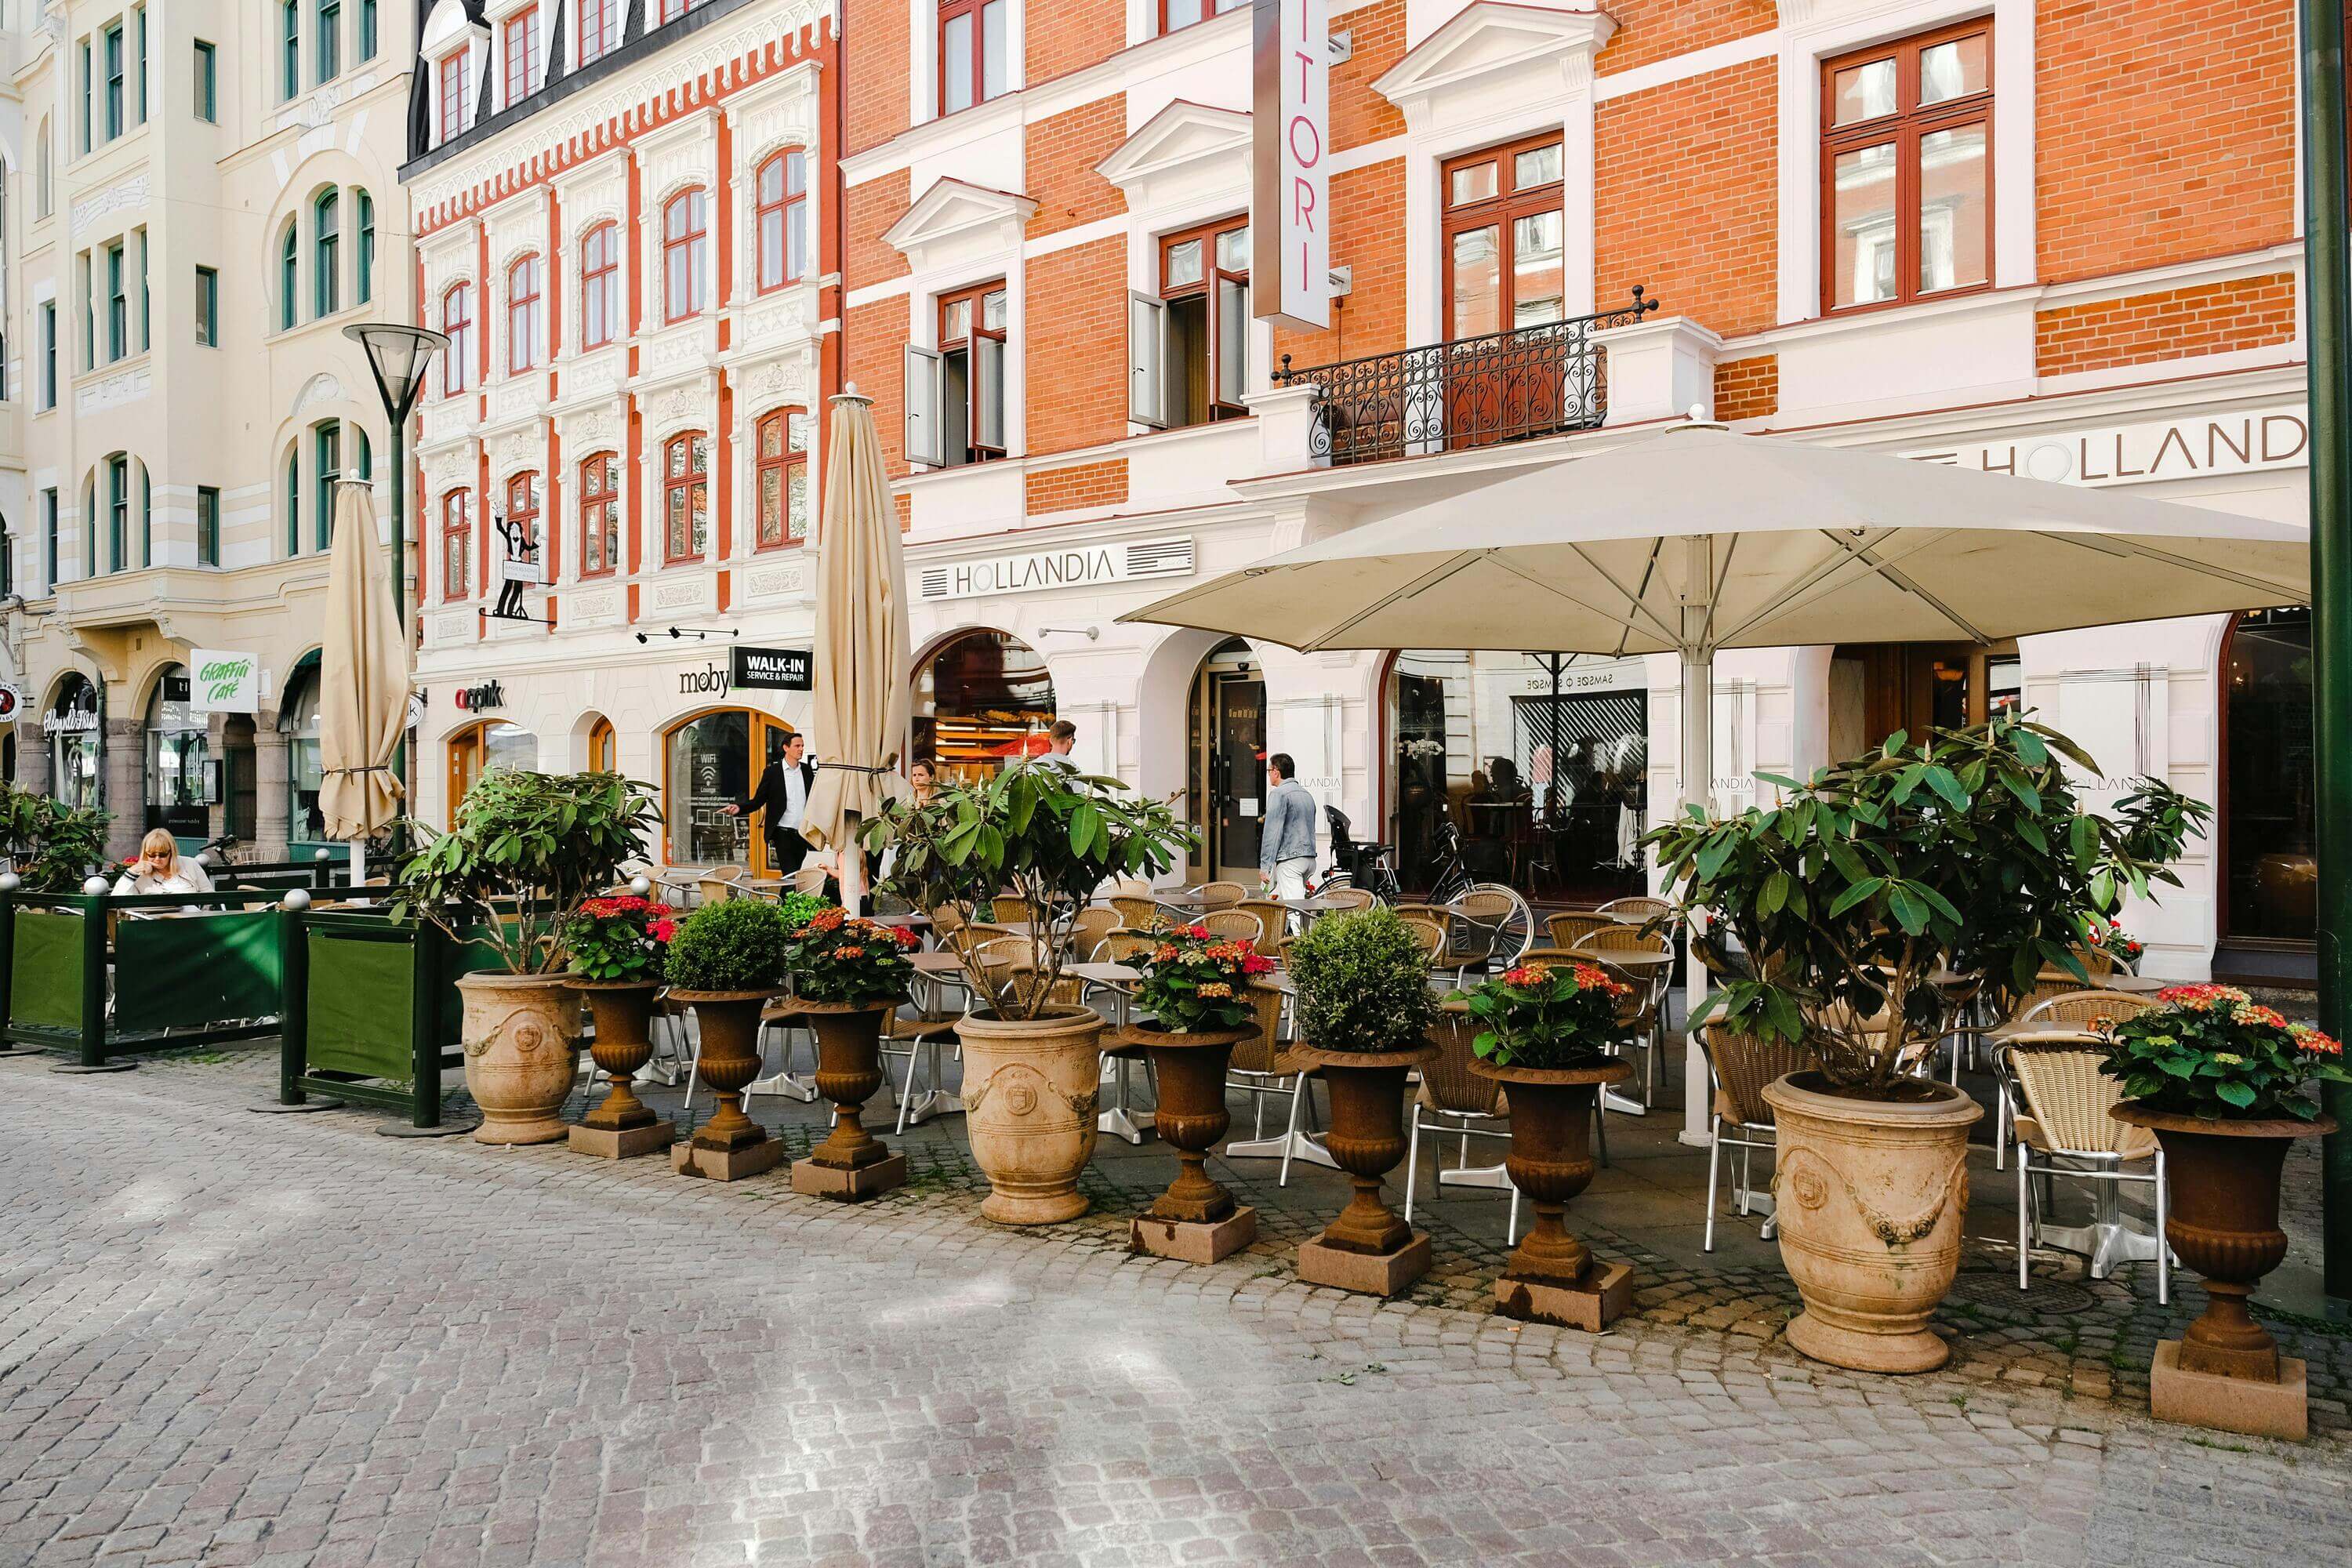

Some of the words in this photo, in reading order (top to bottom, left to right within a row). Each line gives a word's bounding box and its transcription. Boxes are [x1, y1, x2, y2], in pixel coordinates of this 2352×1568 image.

[956, 550, 1114, 593] HOLLANDIA
[746, 655, 804, 673] WALK-IN
[746, 670, 774, 681] SERVICE
[781, 673, 804, 682] REPAIR
[679, 663, 730, 699] moby
